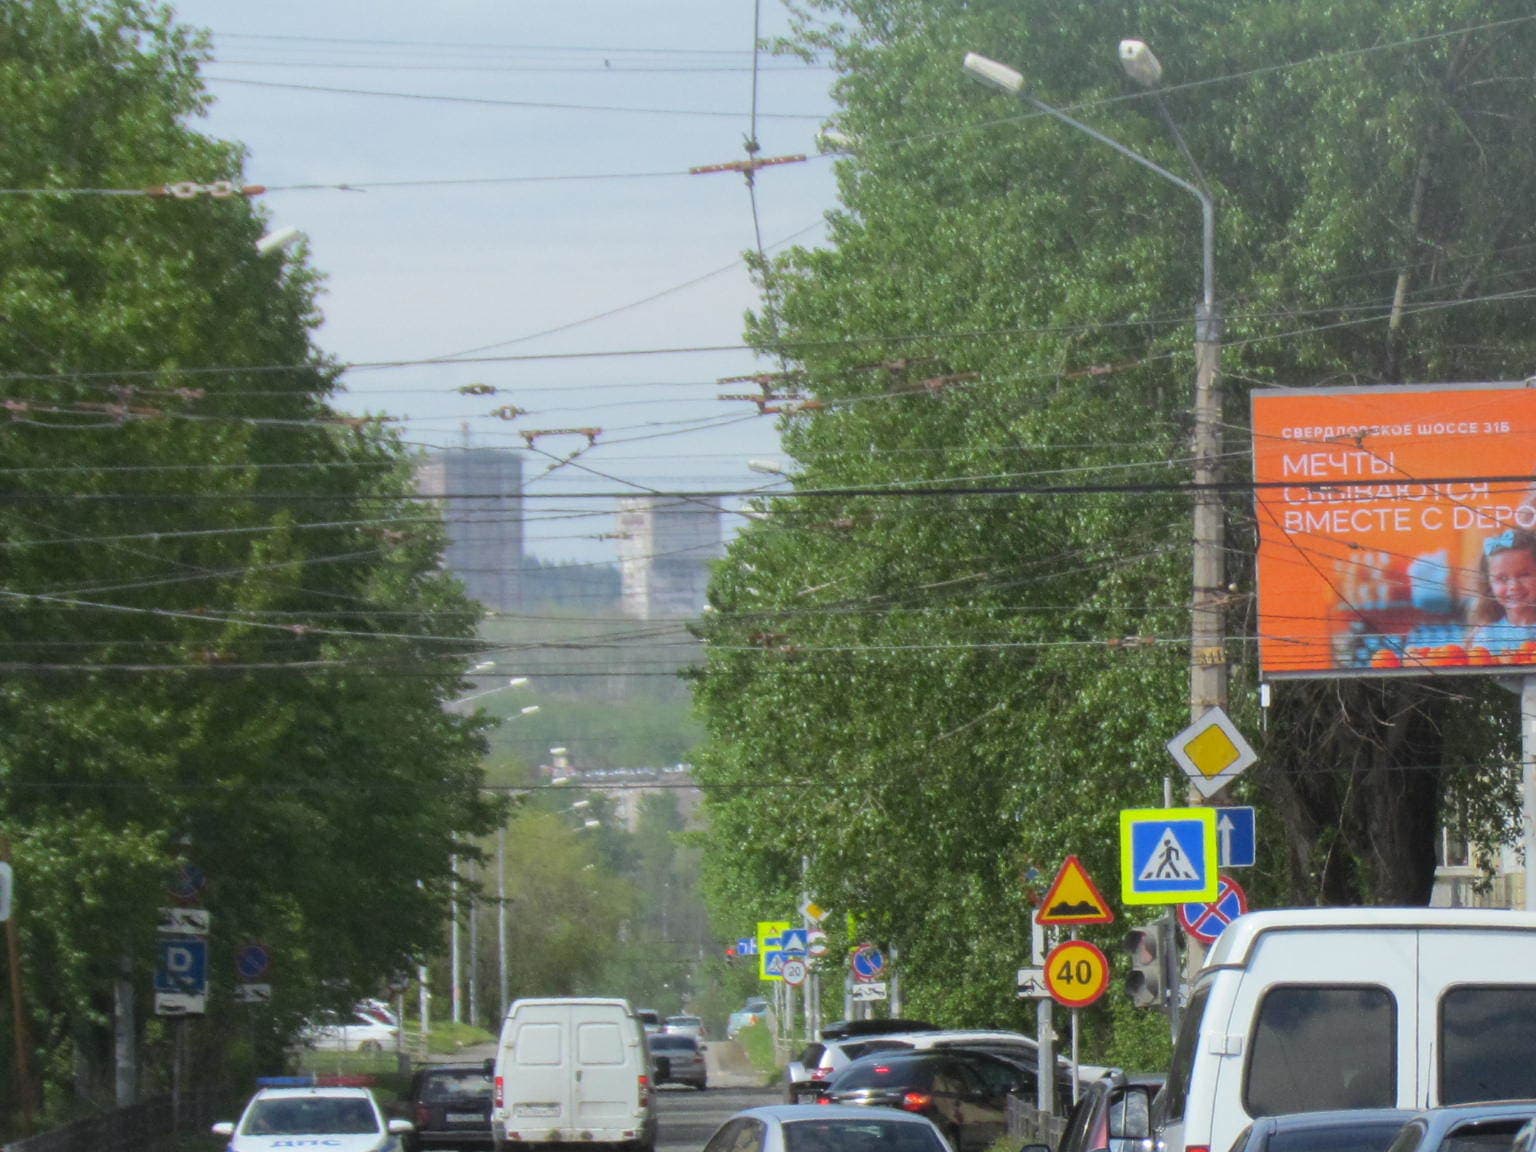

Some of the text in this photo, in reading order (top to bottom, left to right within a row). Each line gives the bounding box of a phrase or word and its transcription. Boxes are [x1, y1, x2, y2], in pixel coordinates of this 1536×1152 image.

[1417, 422, 1478, 435] ШОССЕ
[1484, 421, 1511, 433] 31Б
[1283, 451, 1396, 477] МЕЧТЫ
[1285, 507, 1411, 534] ВМЕСТЕ
[1420, 507, 1443, 531] С
[788, 966, 800, 977] 20
[1056, 959, 1092, 985] 40
[271, 1139, 342, 1148] ДПС
